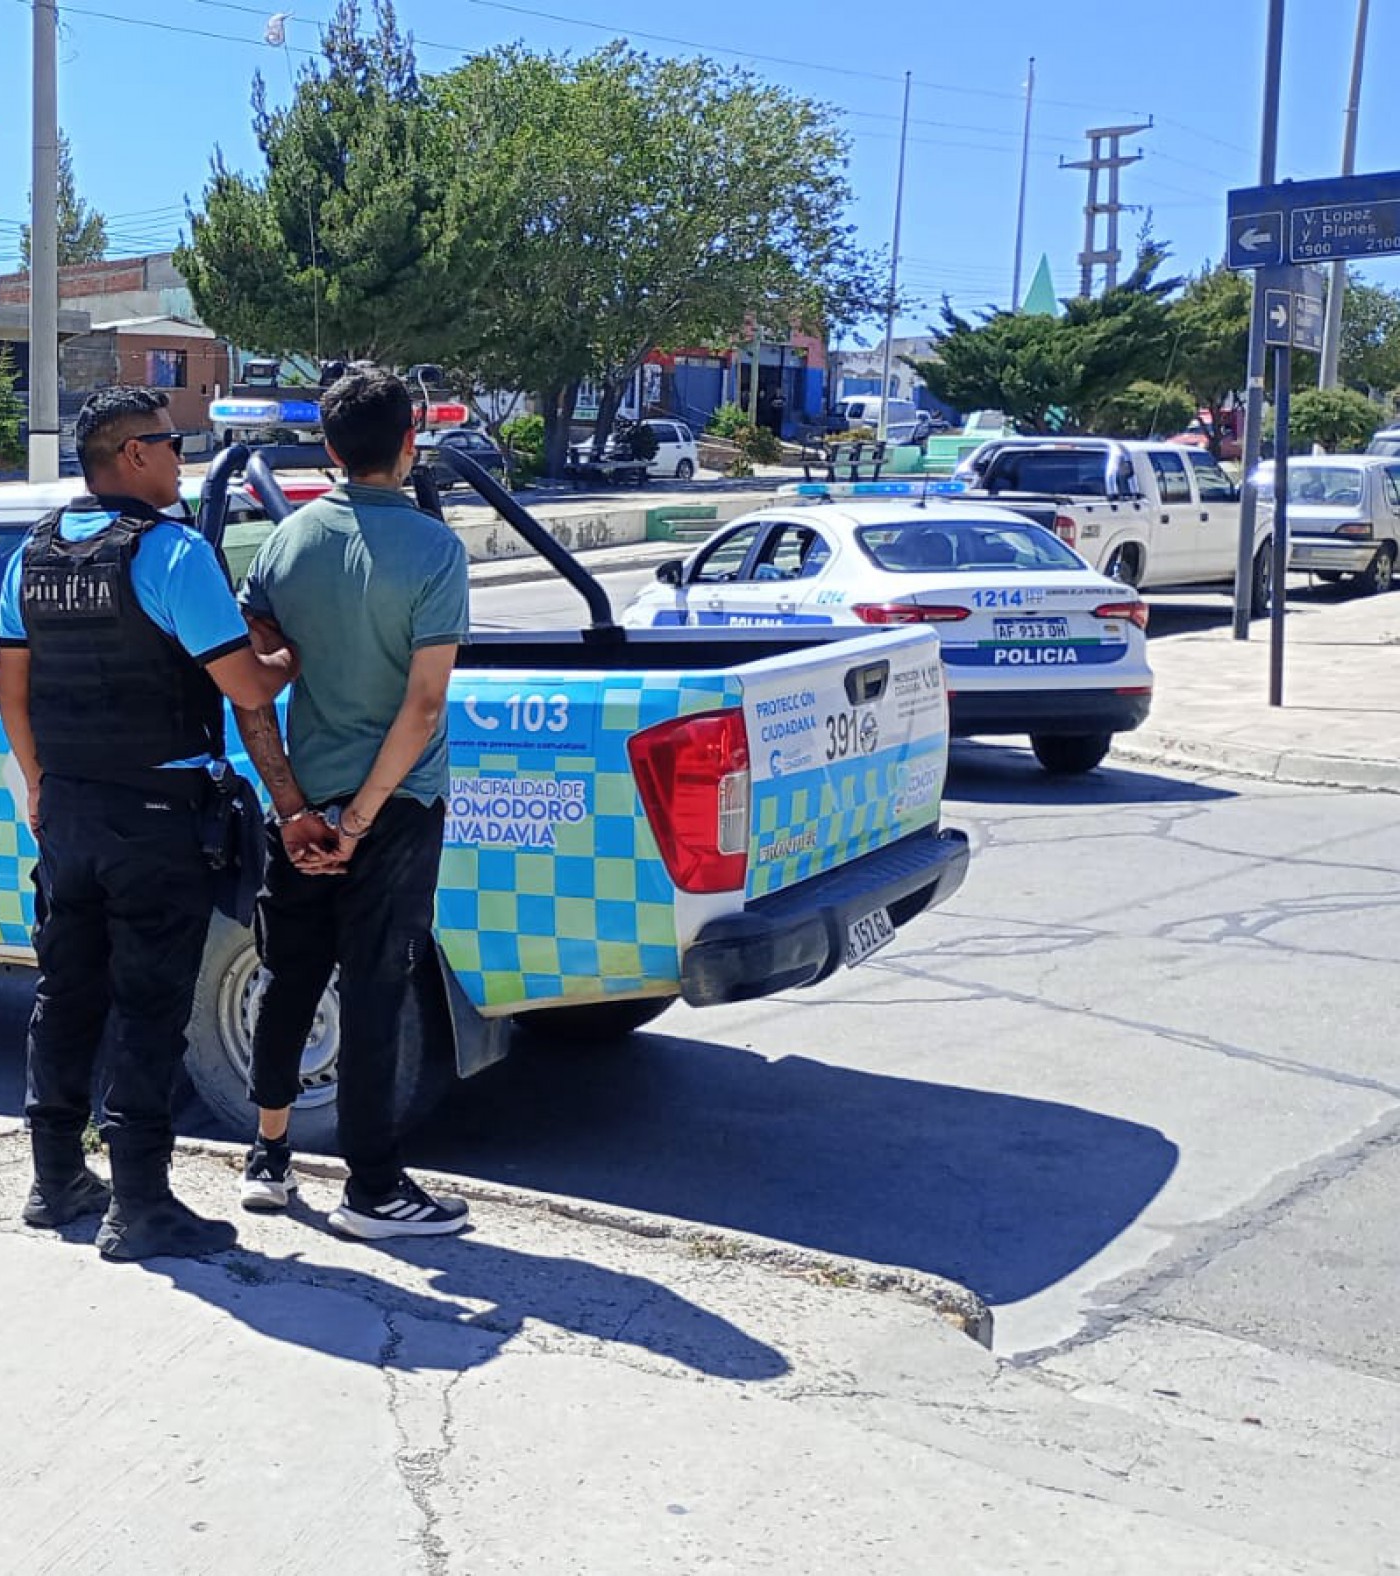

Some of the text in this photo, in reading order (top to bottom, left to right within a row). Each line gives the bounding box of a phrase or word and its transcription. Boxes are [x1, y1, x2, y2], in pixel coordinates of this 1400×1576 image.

[1322, 224, 1376, 237] Planes
[972, 590, 1023, 607] 1214
[995, 648, 1078, 664] POLICIA
[505, 693, 568, 731] 103
[826, 710, 857, 760] 391
[450, 778, 582, 799] UNICIPALIDAD DE
[448, 797, 584, 822] OMODORO
